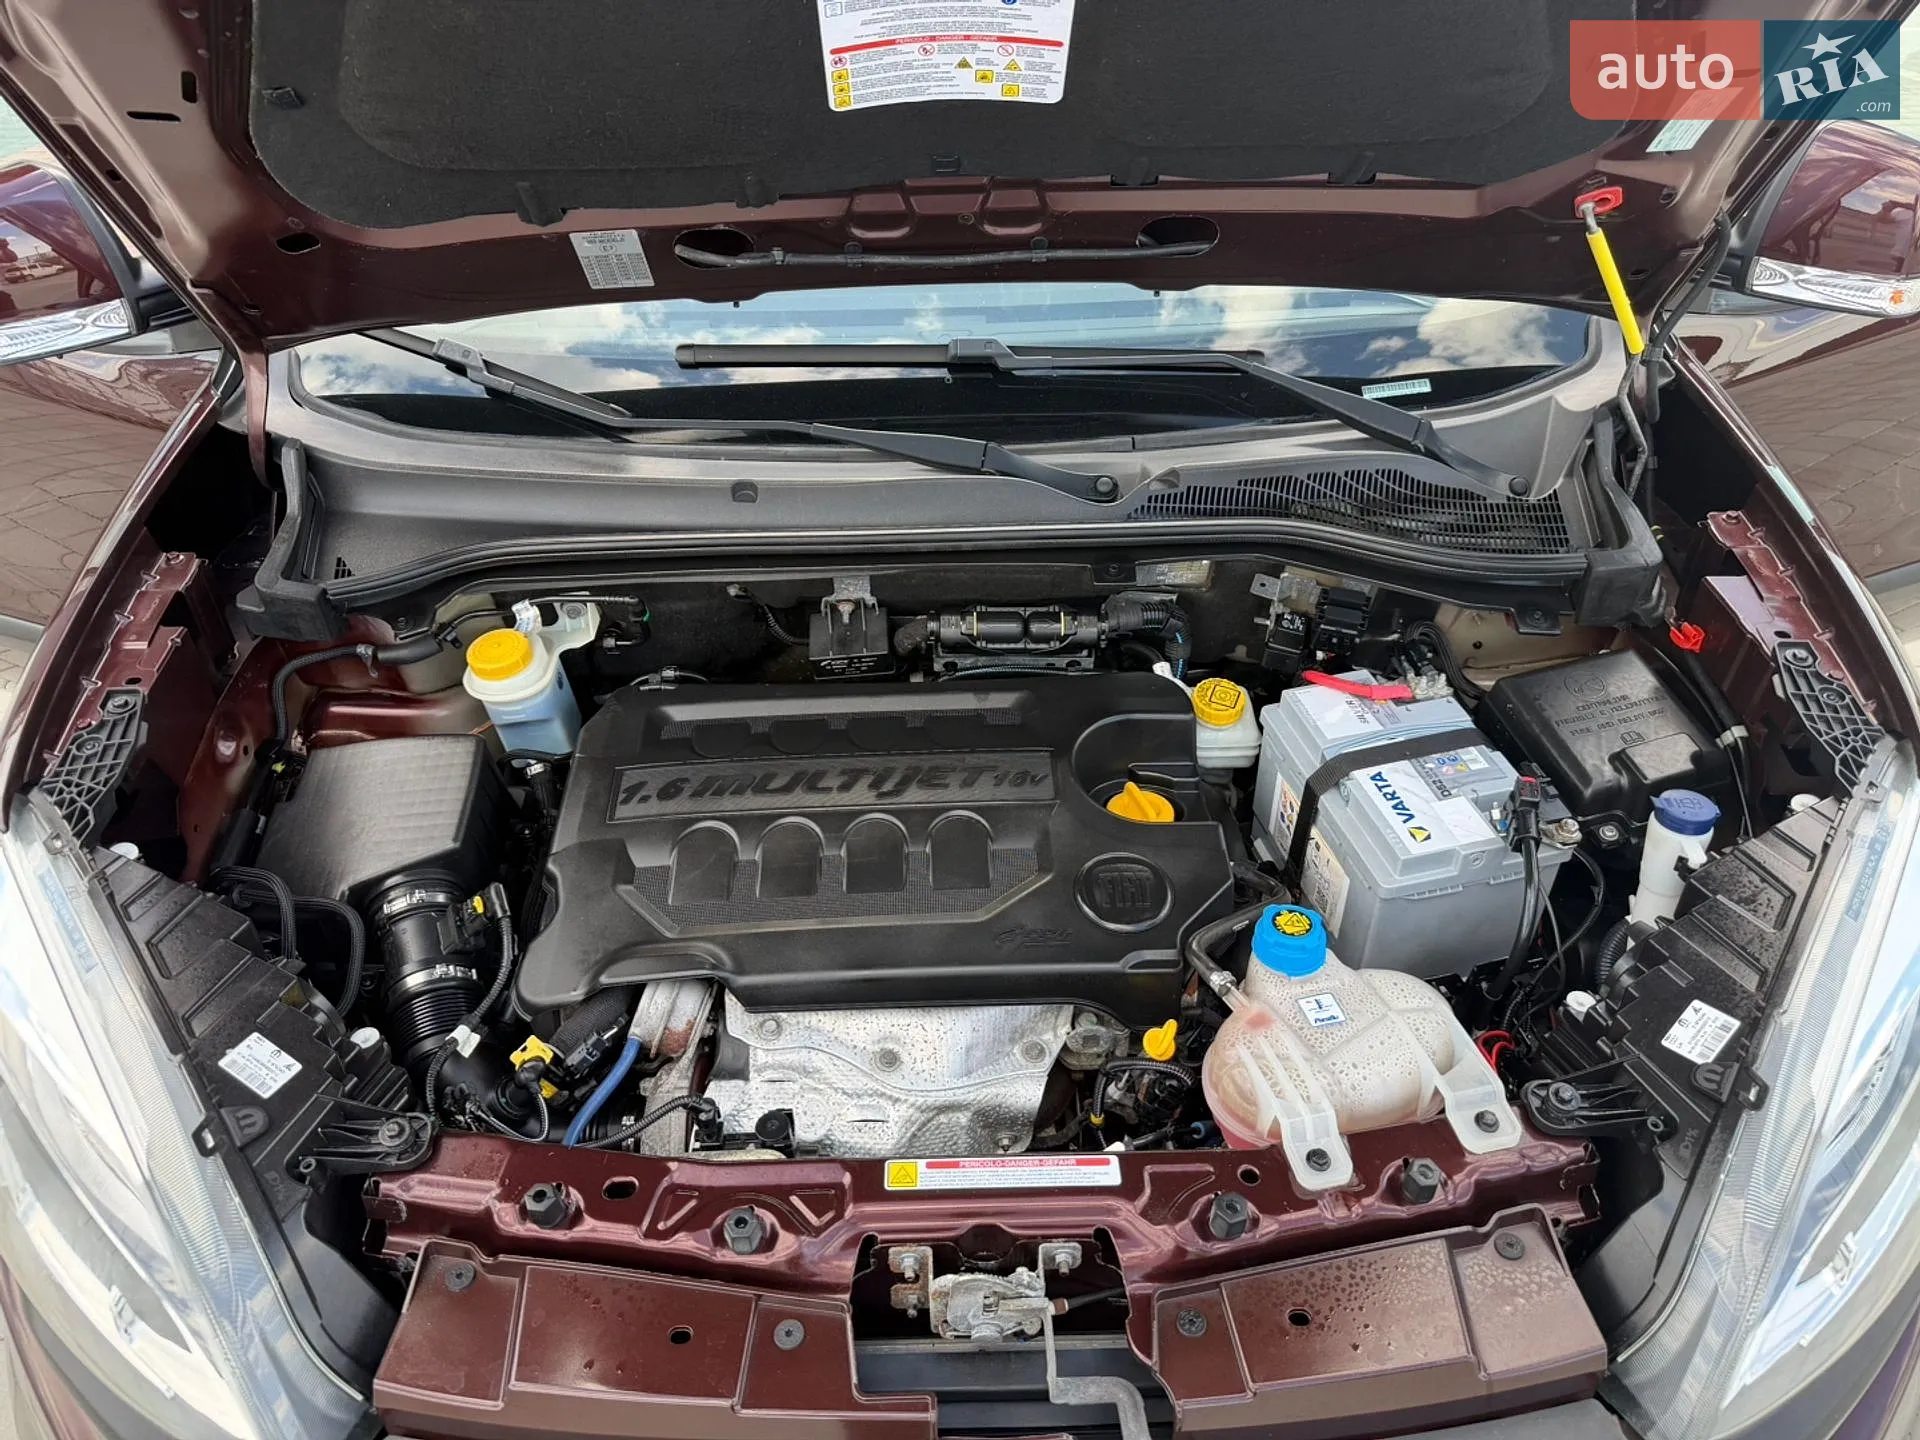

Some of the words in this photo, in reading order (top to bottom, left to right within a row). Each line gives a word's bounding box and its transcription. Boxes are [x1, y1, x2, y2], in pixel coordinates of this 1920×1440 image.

[619, 777, 691, 806] 1.6
[1370, 771, 1415, 824] VARTA
[1432, 779, 1452, 798] D52
